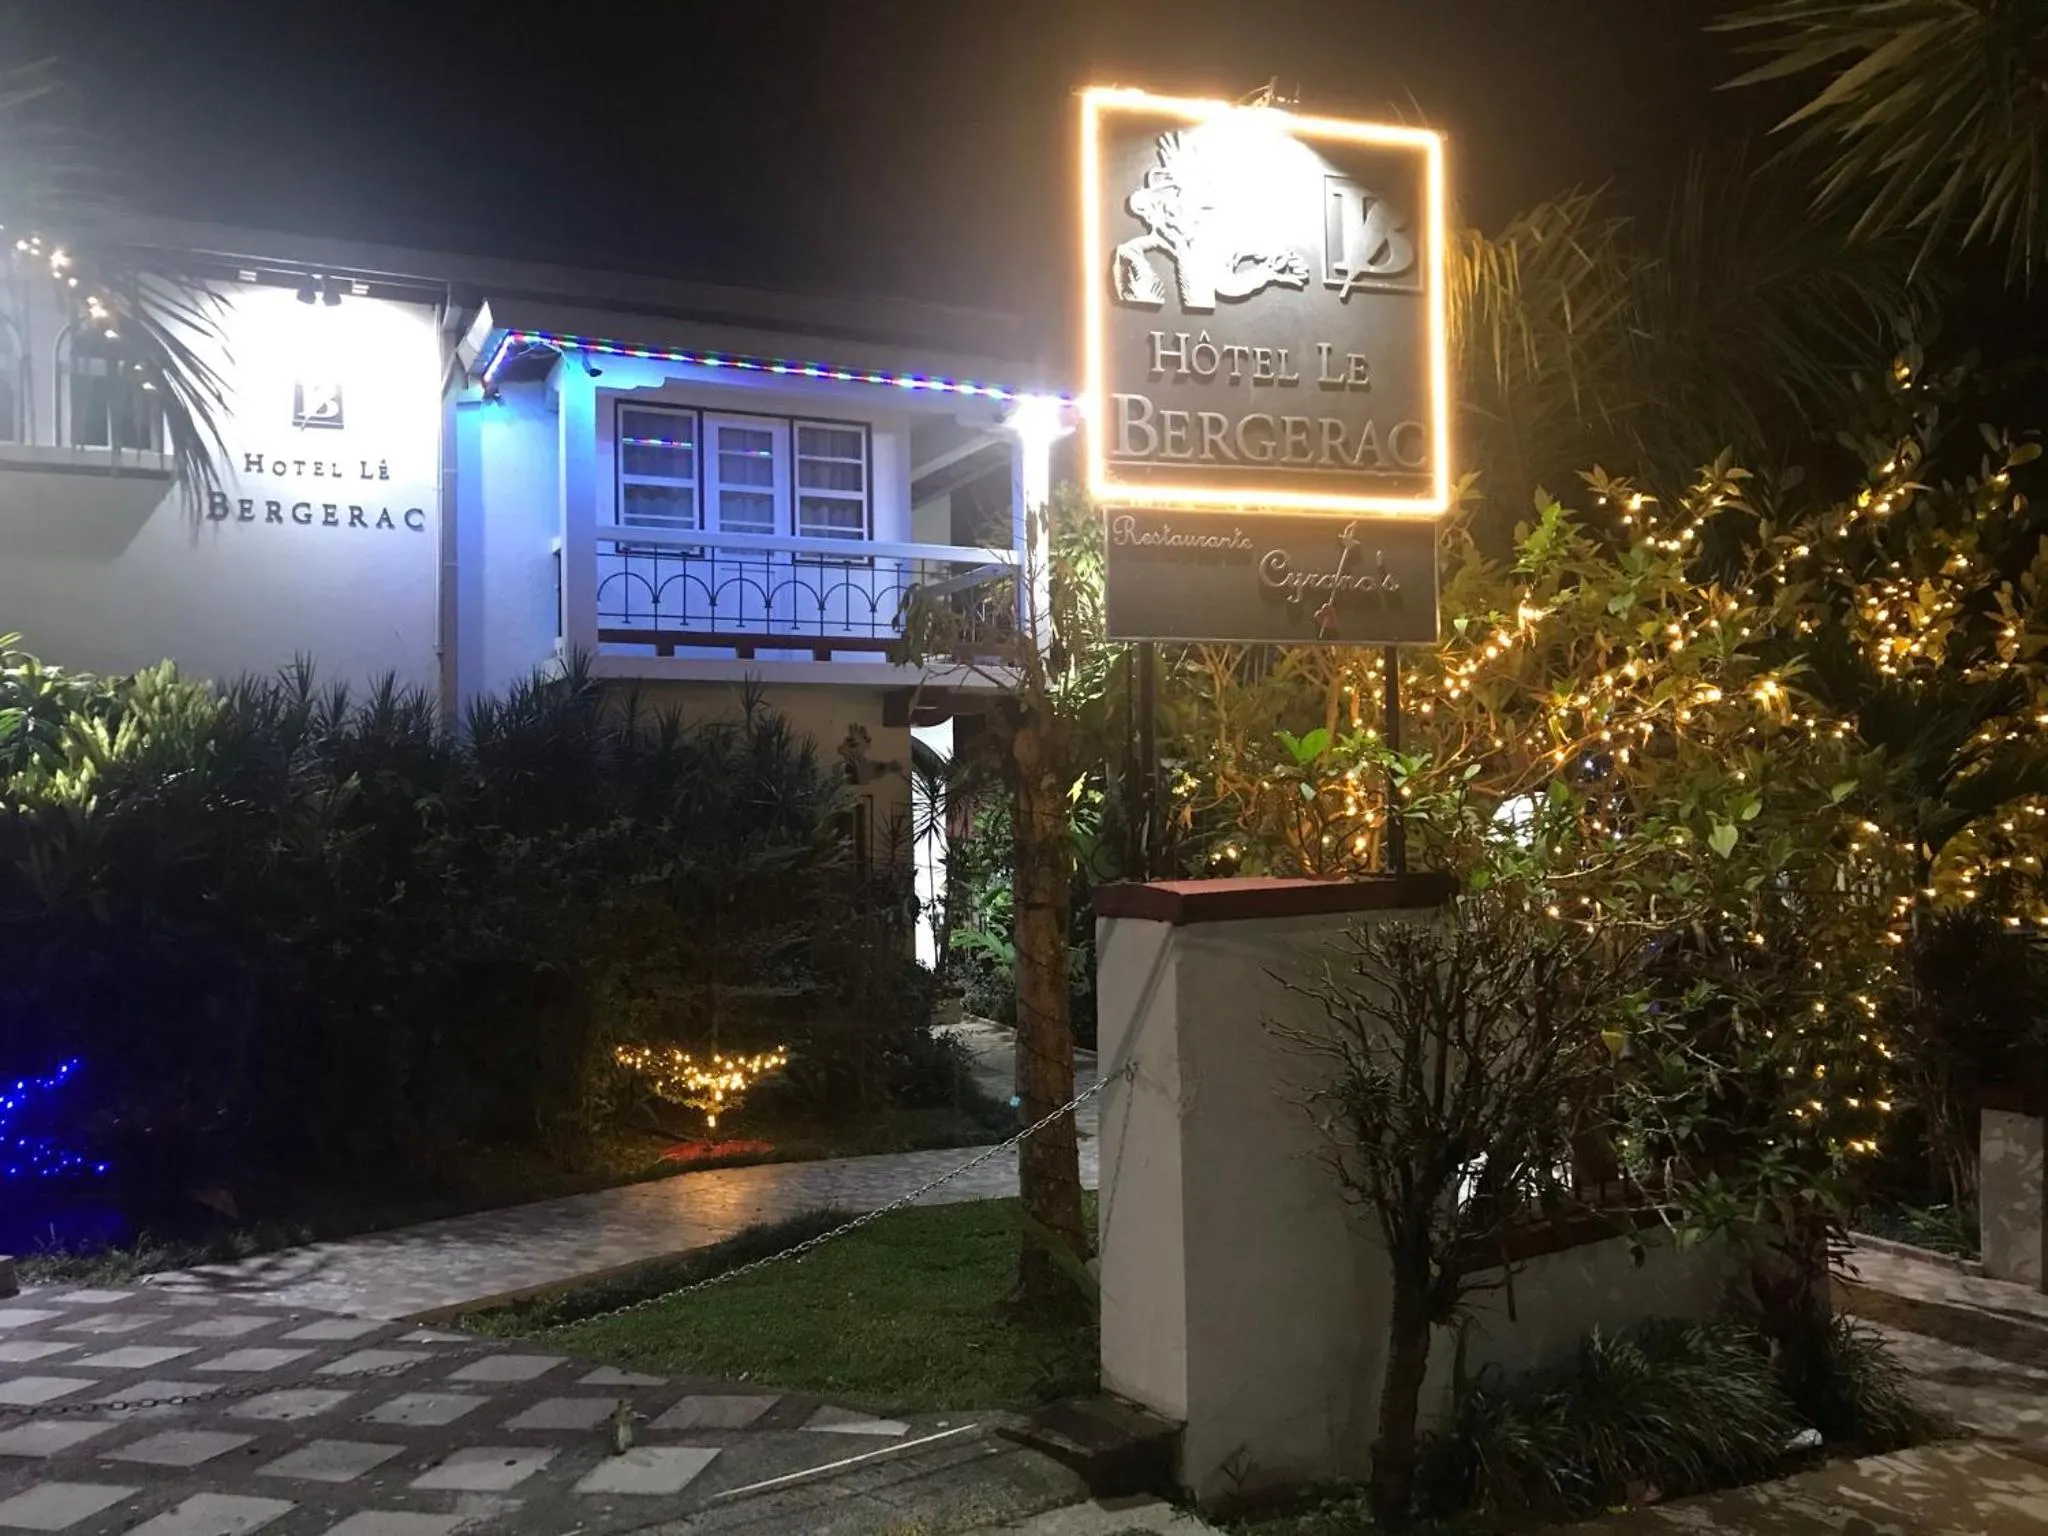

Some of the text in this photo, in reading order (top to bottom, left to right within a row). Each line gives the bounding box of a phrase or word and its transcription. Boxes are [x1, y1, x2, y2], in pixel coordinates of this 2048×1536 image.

[1149, 328, 1372, 387] HÔTEL LE
[1111, 392, 1429, 470] BERGERAC
[243, 452, 343, 479] HOTEL
[205, 490, 427, 533] BERGERAC
